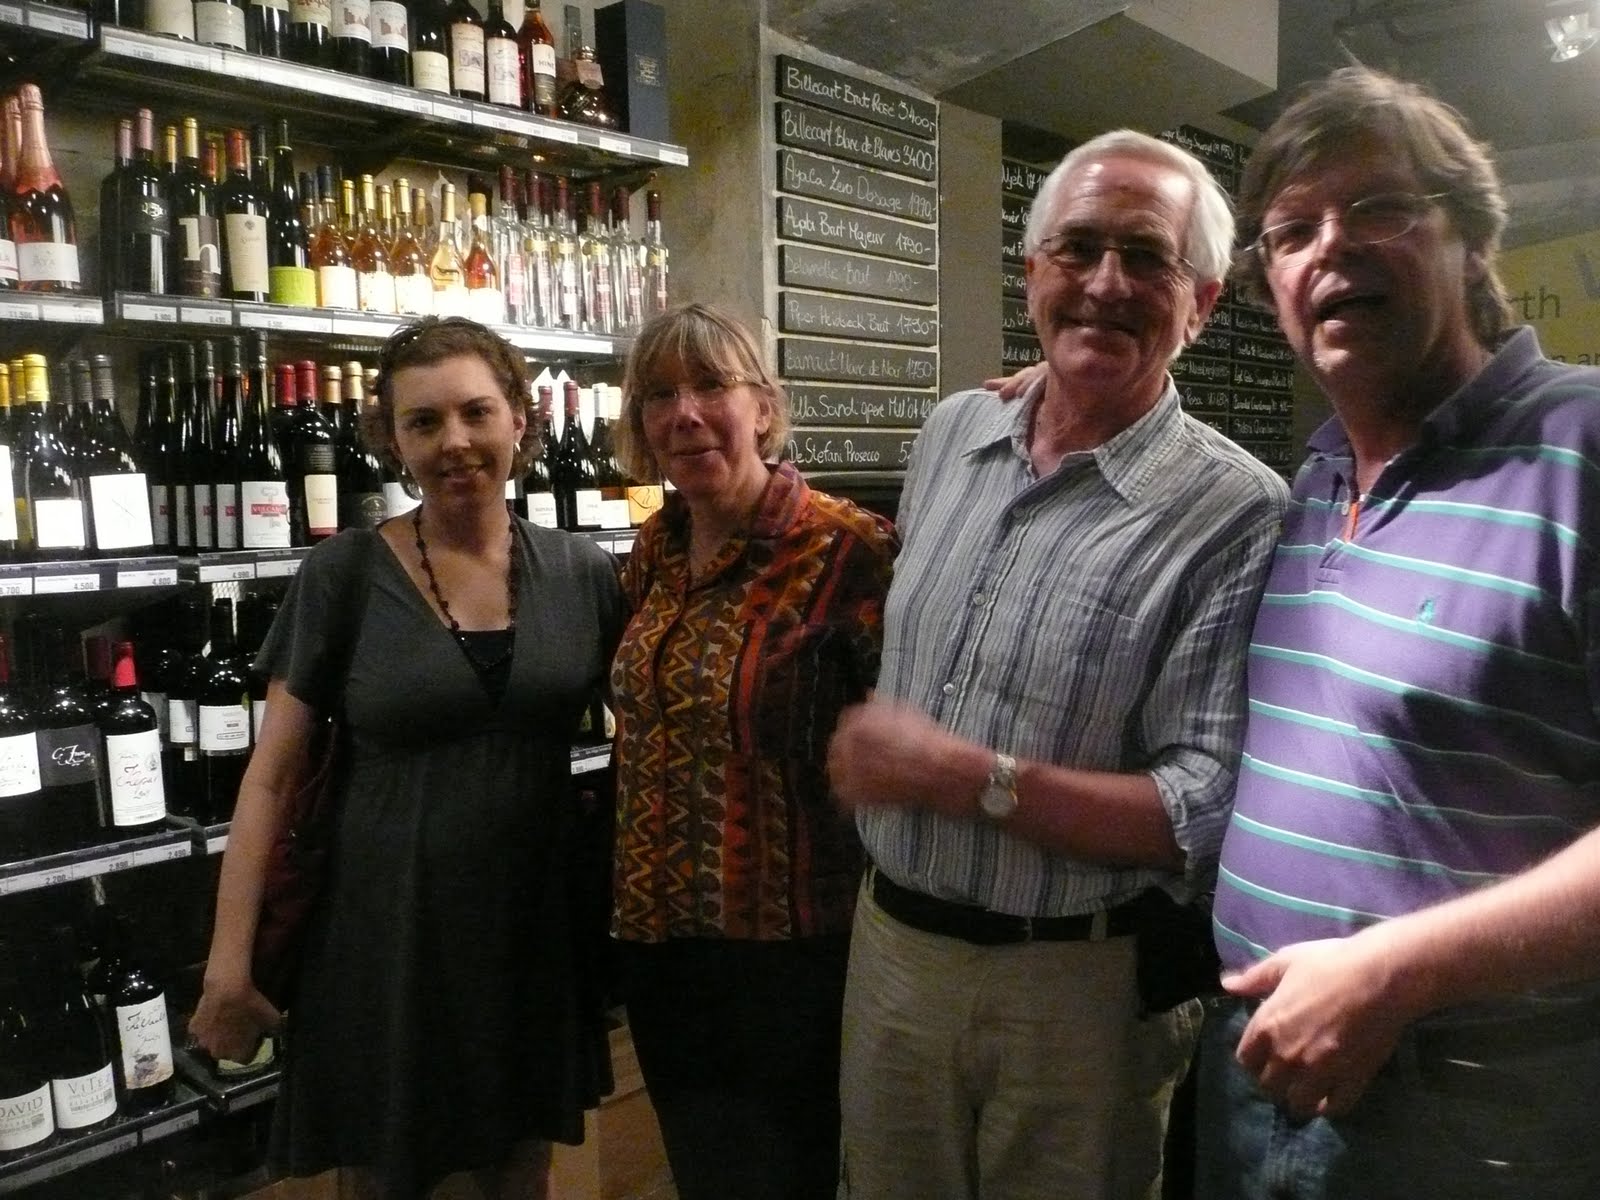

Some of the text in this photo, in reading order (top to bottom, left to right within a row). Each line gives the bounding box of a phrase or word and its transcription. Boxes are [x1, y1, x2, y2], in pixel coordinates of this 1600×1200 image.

[787, 66, 841, 99] Billecart
[844, 84, 870, 108] Brut
[784, 109, 832, 146] Billecart
[862, 135, 873, 154] de
[785, 153, 826, 189] Ayala
[830, 166, 853, 194] Zero
[856, 176, 902, 212] Dosage
[818, 211, 846, 238] Brut
[848, 222, 886, 249] Majeur
[868, 312, 890, 333] Brut
[788, 439, 803, 464] De
[805, 437, 843, 464] Stefani
[844, 440, 880, 463] Prosecco
